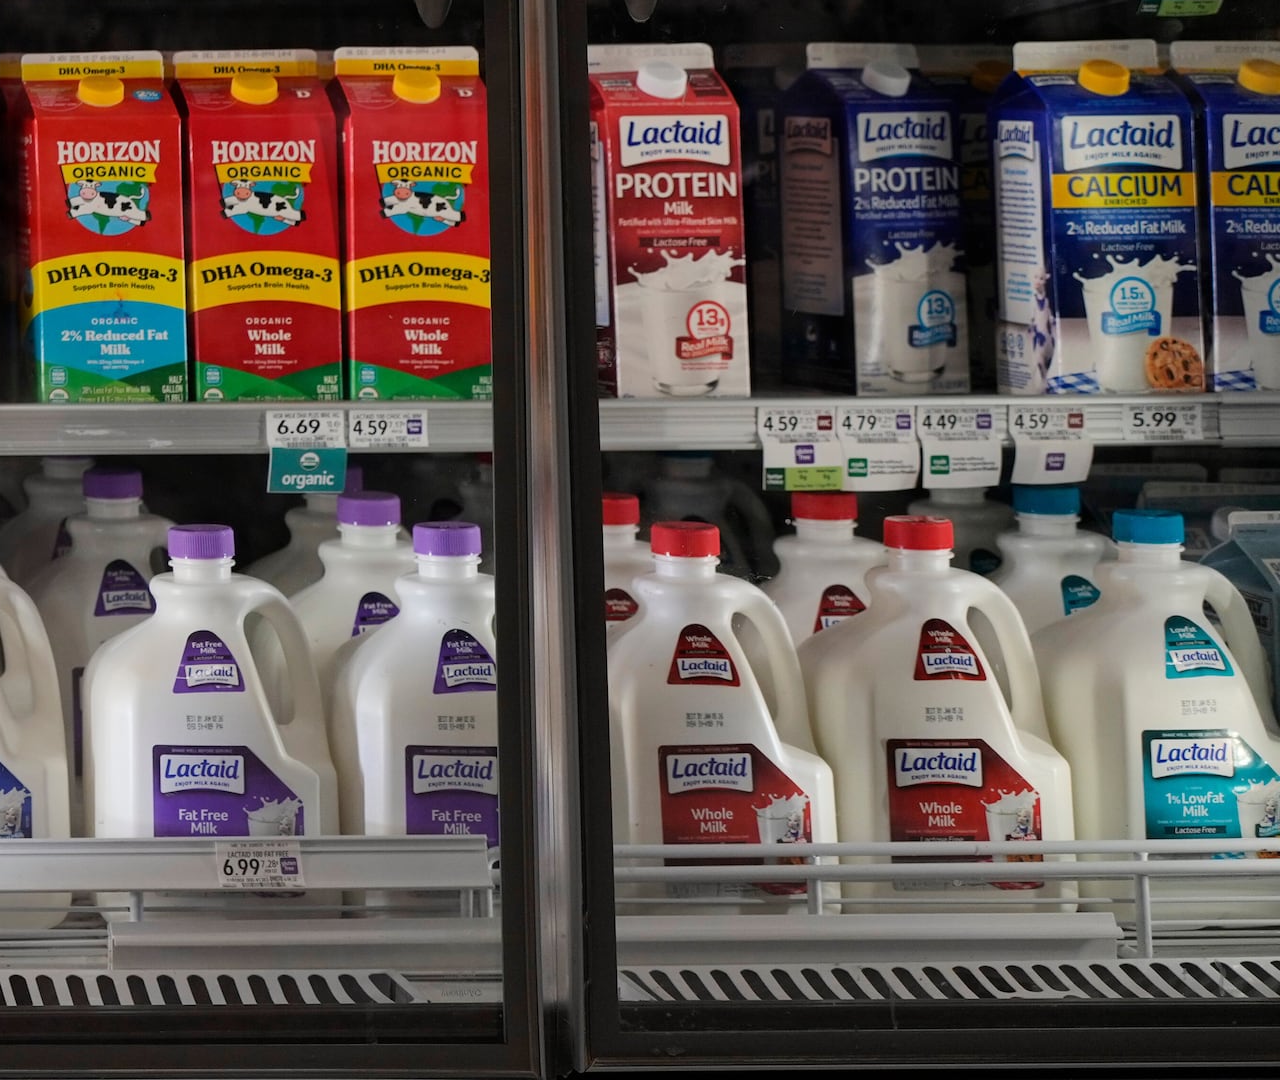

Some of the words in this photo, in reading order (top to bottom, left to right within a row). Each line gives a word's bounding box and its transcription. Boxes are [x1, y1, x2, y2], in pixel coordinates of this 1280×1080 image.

[615, 172, 737, 199] PROTEIN
[854, 167, 959, 192] PROTEIN
[1067, 175, 1182, 197] CALCIUM
[47, 265, 90, 285] DHA
[94, 262, 178, 283] Omega-3
[61, 330, 82, 342] 2%
[85, 329, 146, 341] Reduced
[148, 329, 169, 341] Fat
[248, 329, 291, 341] Whole
[277, 419, 320, 434] 6.69
[763, 415, 798, 432] 4.59
[842, 415, 877, 431] 4.79
[923, 414, 957, 429] 4.49
[1132, 412, 1176, 427] 5.99
[353, 420, 387, 436] 4.59
[164, 759, 239, 780] Lactaid
[418, 759, 493, 780] Lactaid
[1165, 793, 1181, 804] 1%
[1181, 792, 1224, 805] Lowfat
[179, 809, 196, 821] Fat
[199, 809, 229, 821] Free
[432, 810, 449, 822] Fat
[452, 810, 482, 822] Free
[691, 808, 733, 820] Whole
[700, 821, 727, 833] Milk
[1175, 826, 1200, 834] Lactose
[1201, 826, 1216, 834] Free
[223, 858, 260, 877] 6.99
